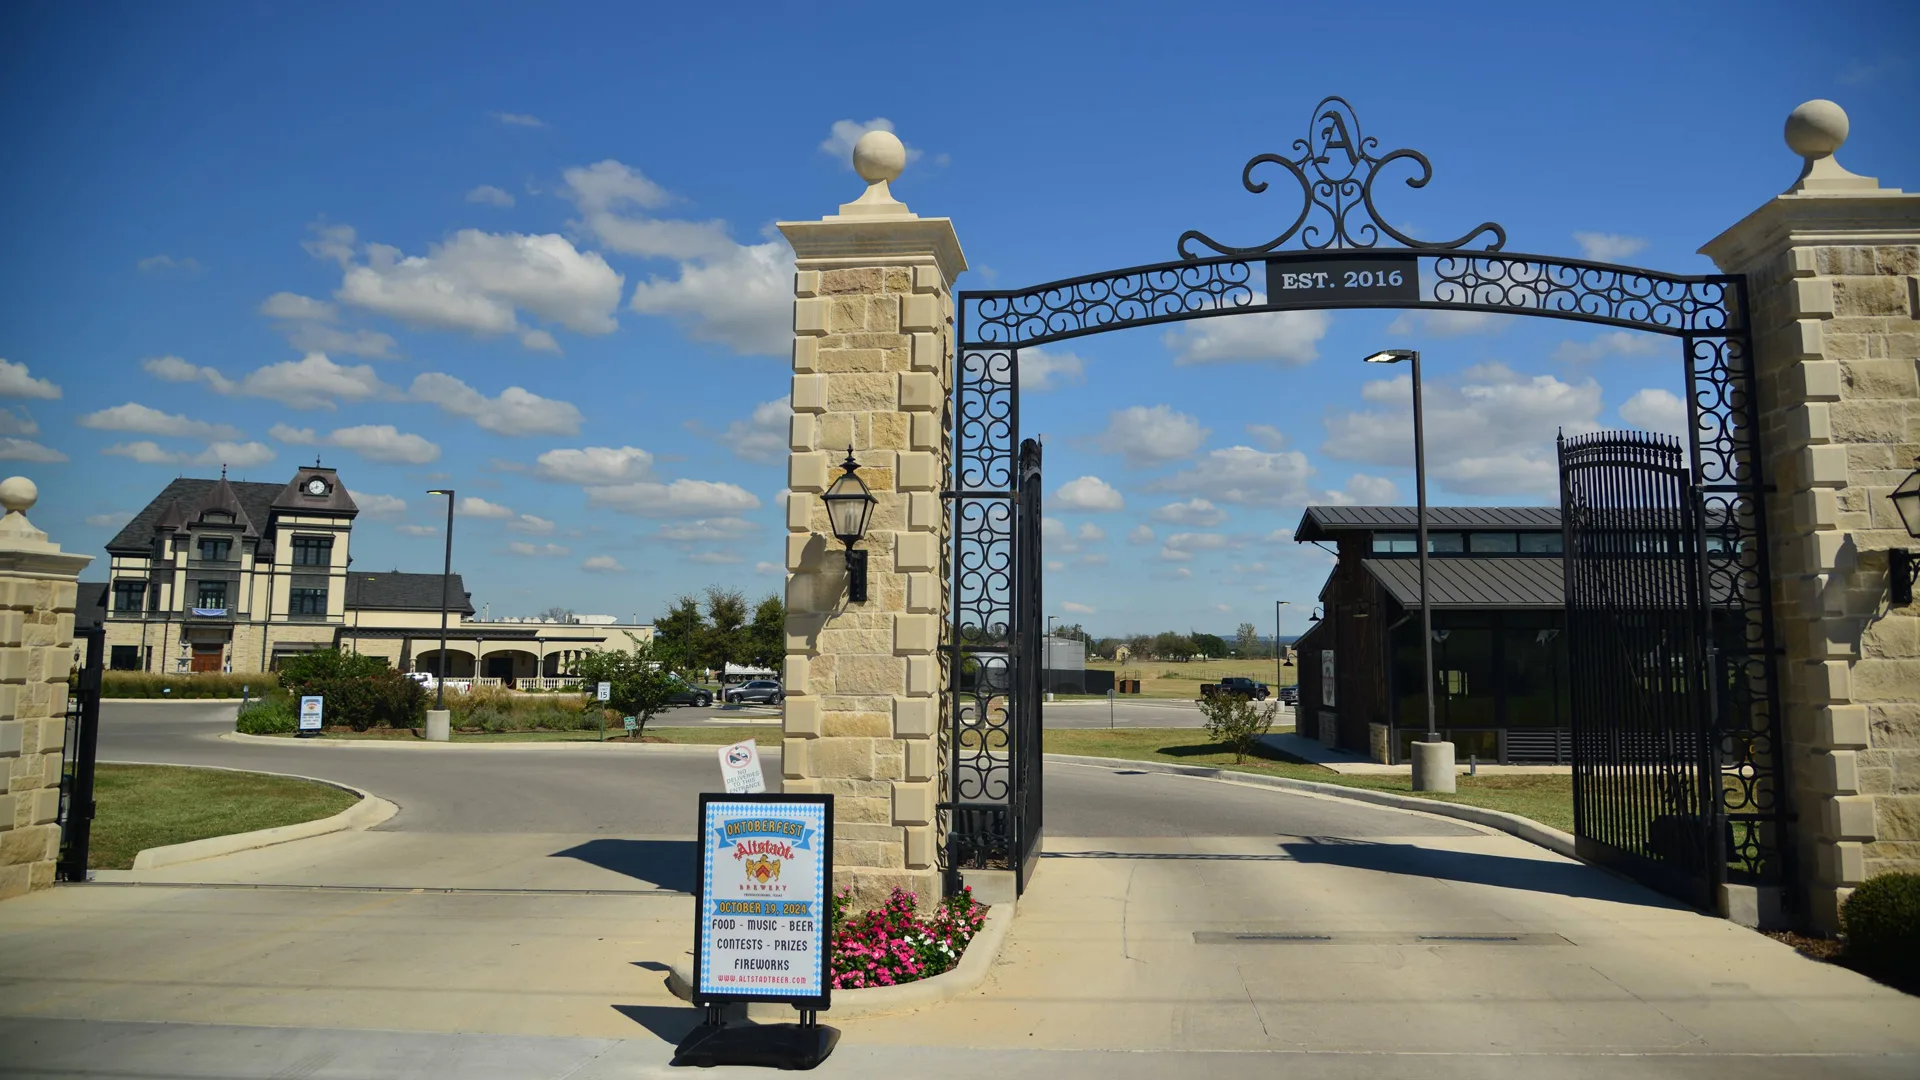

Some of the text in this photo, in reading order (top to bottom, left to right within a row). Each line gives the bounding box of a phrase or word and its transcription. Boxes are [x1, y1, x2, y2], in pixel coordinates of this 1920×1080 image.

[1282, 270, 1403, 289] EST. 2016
[727, 771, 759, 783] DELIVERIES
[727, 820, 802, 836] OKTOBERFEST
[737, 840, 791, 860] Altstadt
[719, 901, 808, 916] OCTOBER 19, 2024
[712, 919, 735, 930] FOOD
[748, 919, 777, 931] MUSIC
[789, 921, 813, 932] BEER
[717, 938, 762, 950] CONTESTS
[774, 940, 807, 951] PRIZES
[734, 959, 790, 971] FIREWORKS
